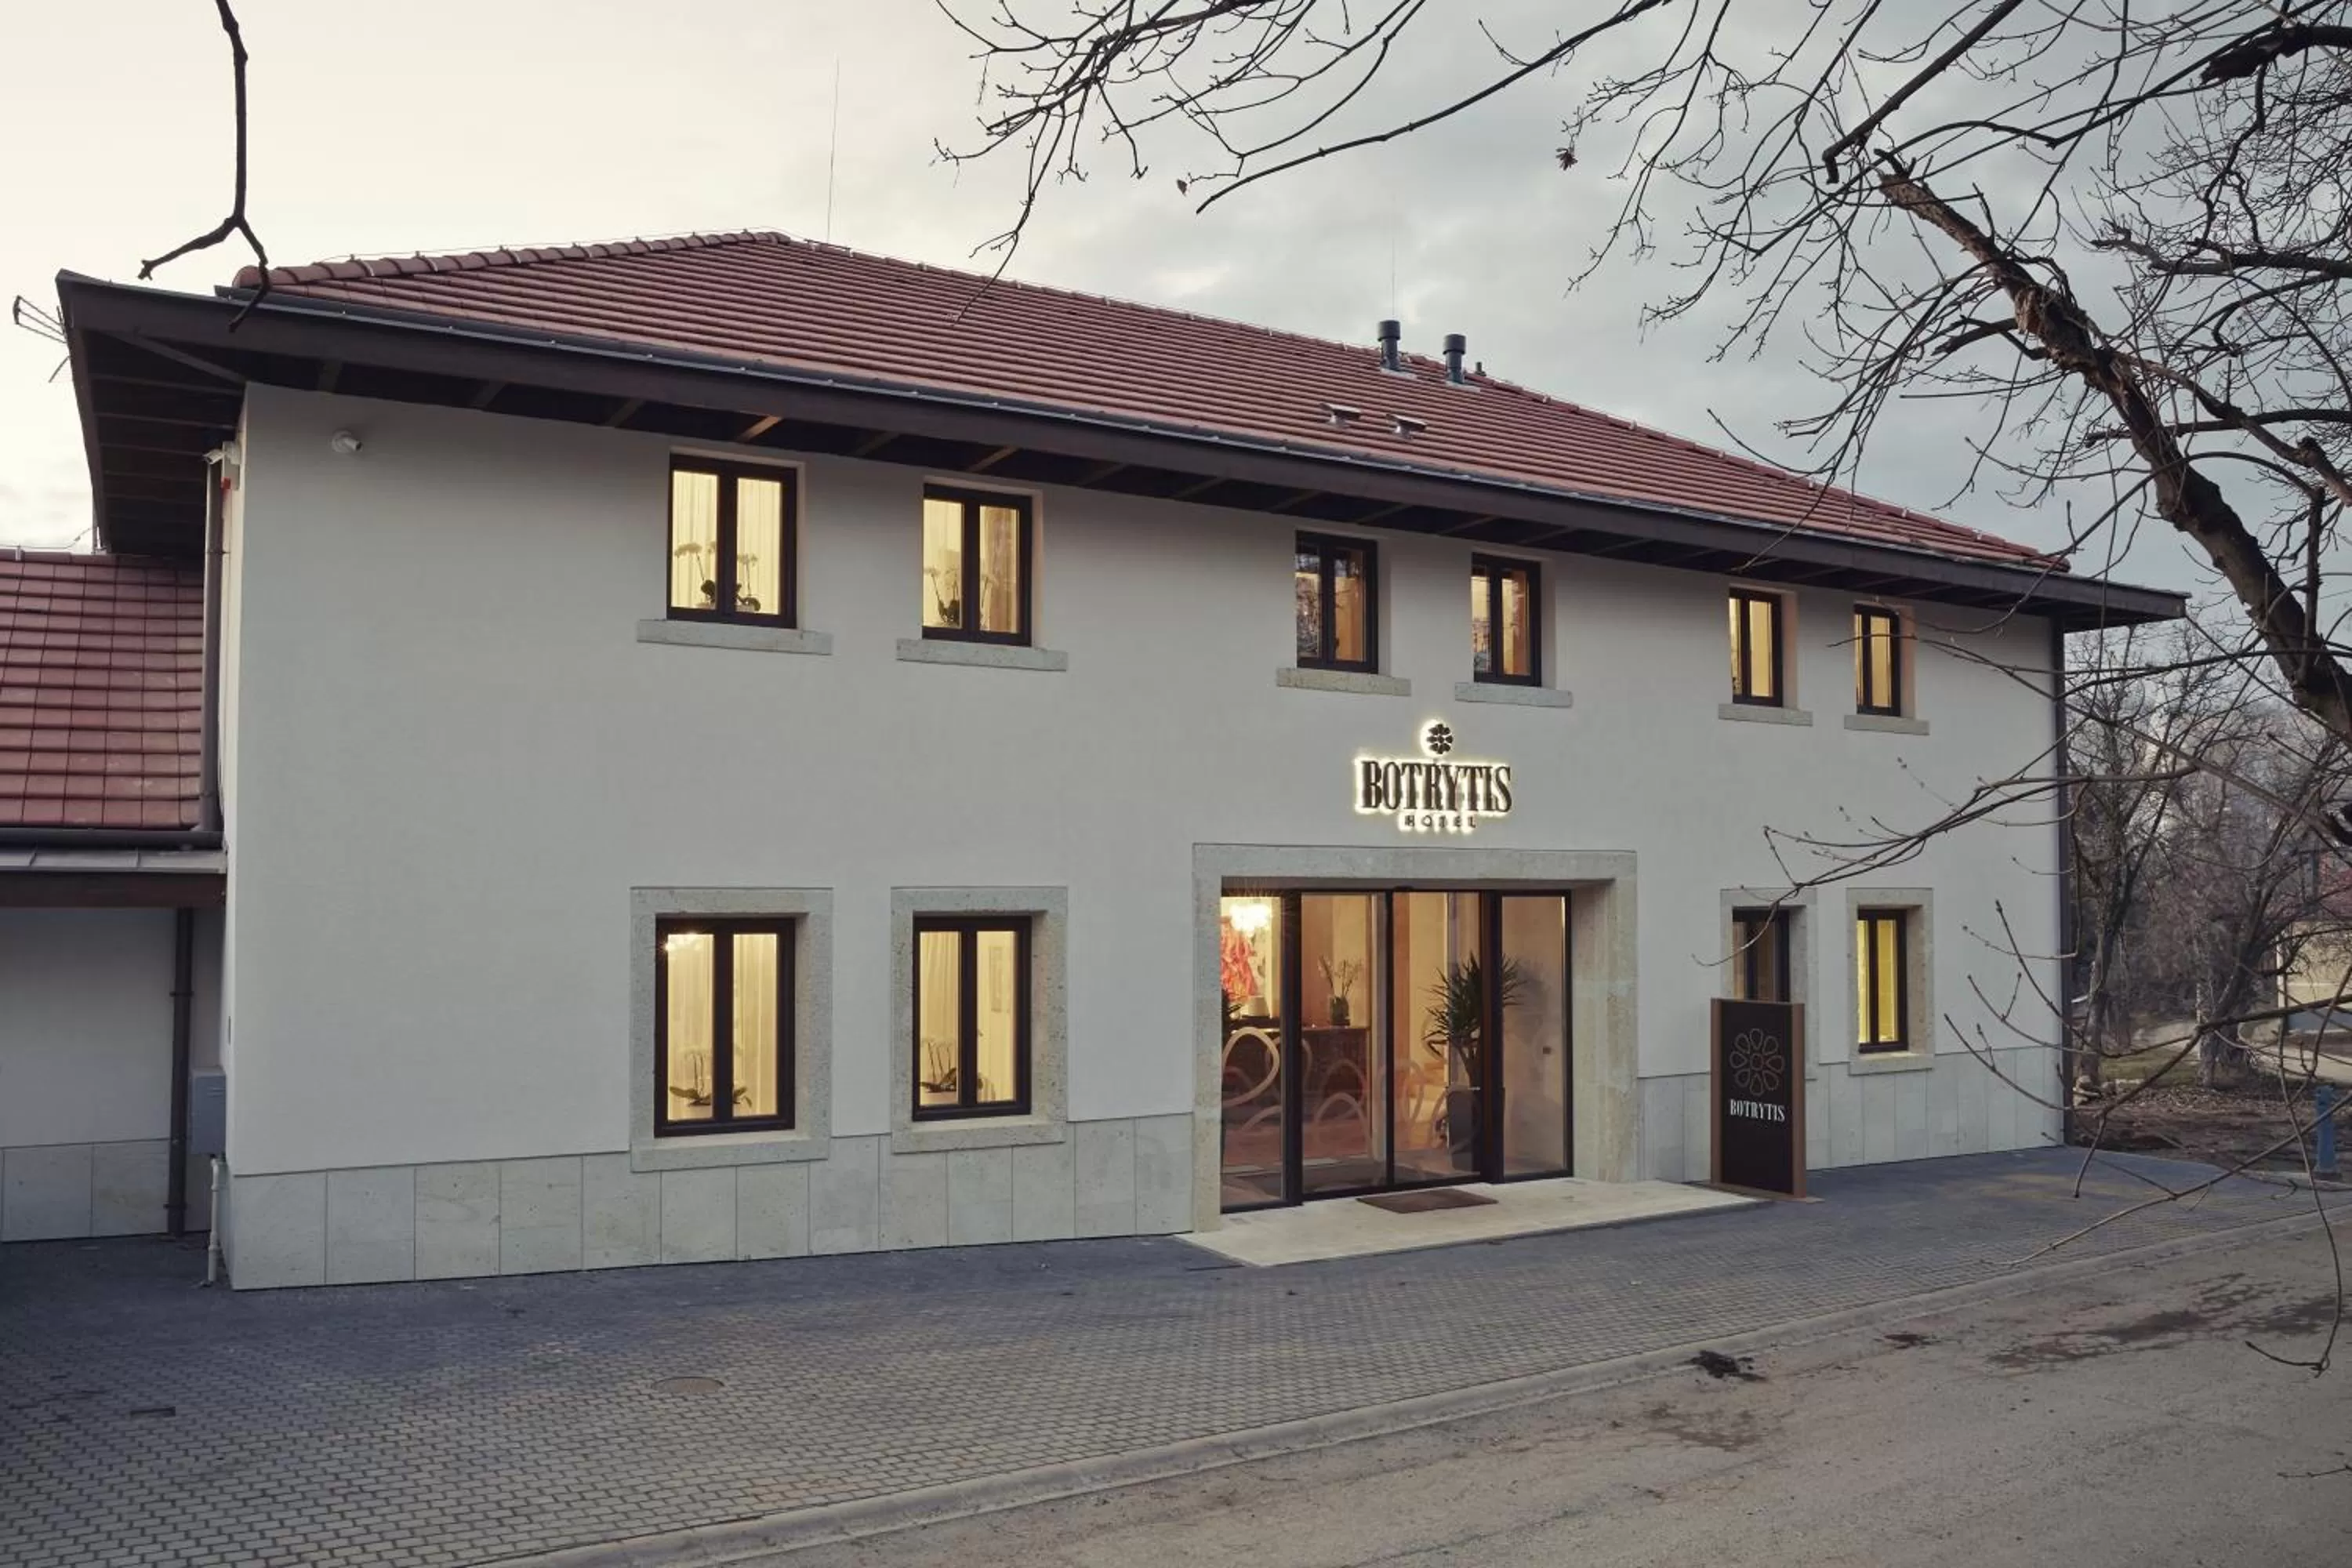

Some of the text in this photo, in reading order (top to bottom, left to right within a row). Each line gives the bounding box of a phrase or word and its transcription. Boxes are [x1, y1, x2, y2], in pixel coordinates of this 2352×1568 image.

[1361, 760, 1512, 812] BOTRYTIS
[1404, 815, 1476, 829] HOTEL
[1730, 1098, 1785, 1122] BOTRYTIS
